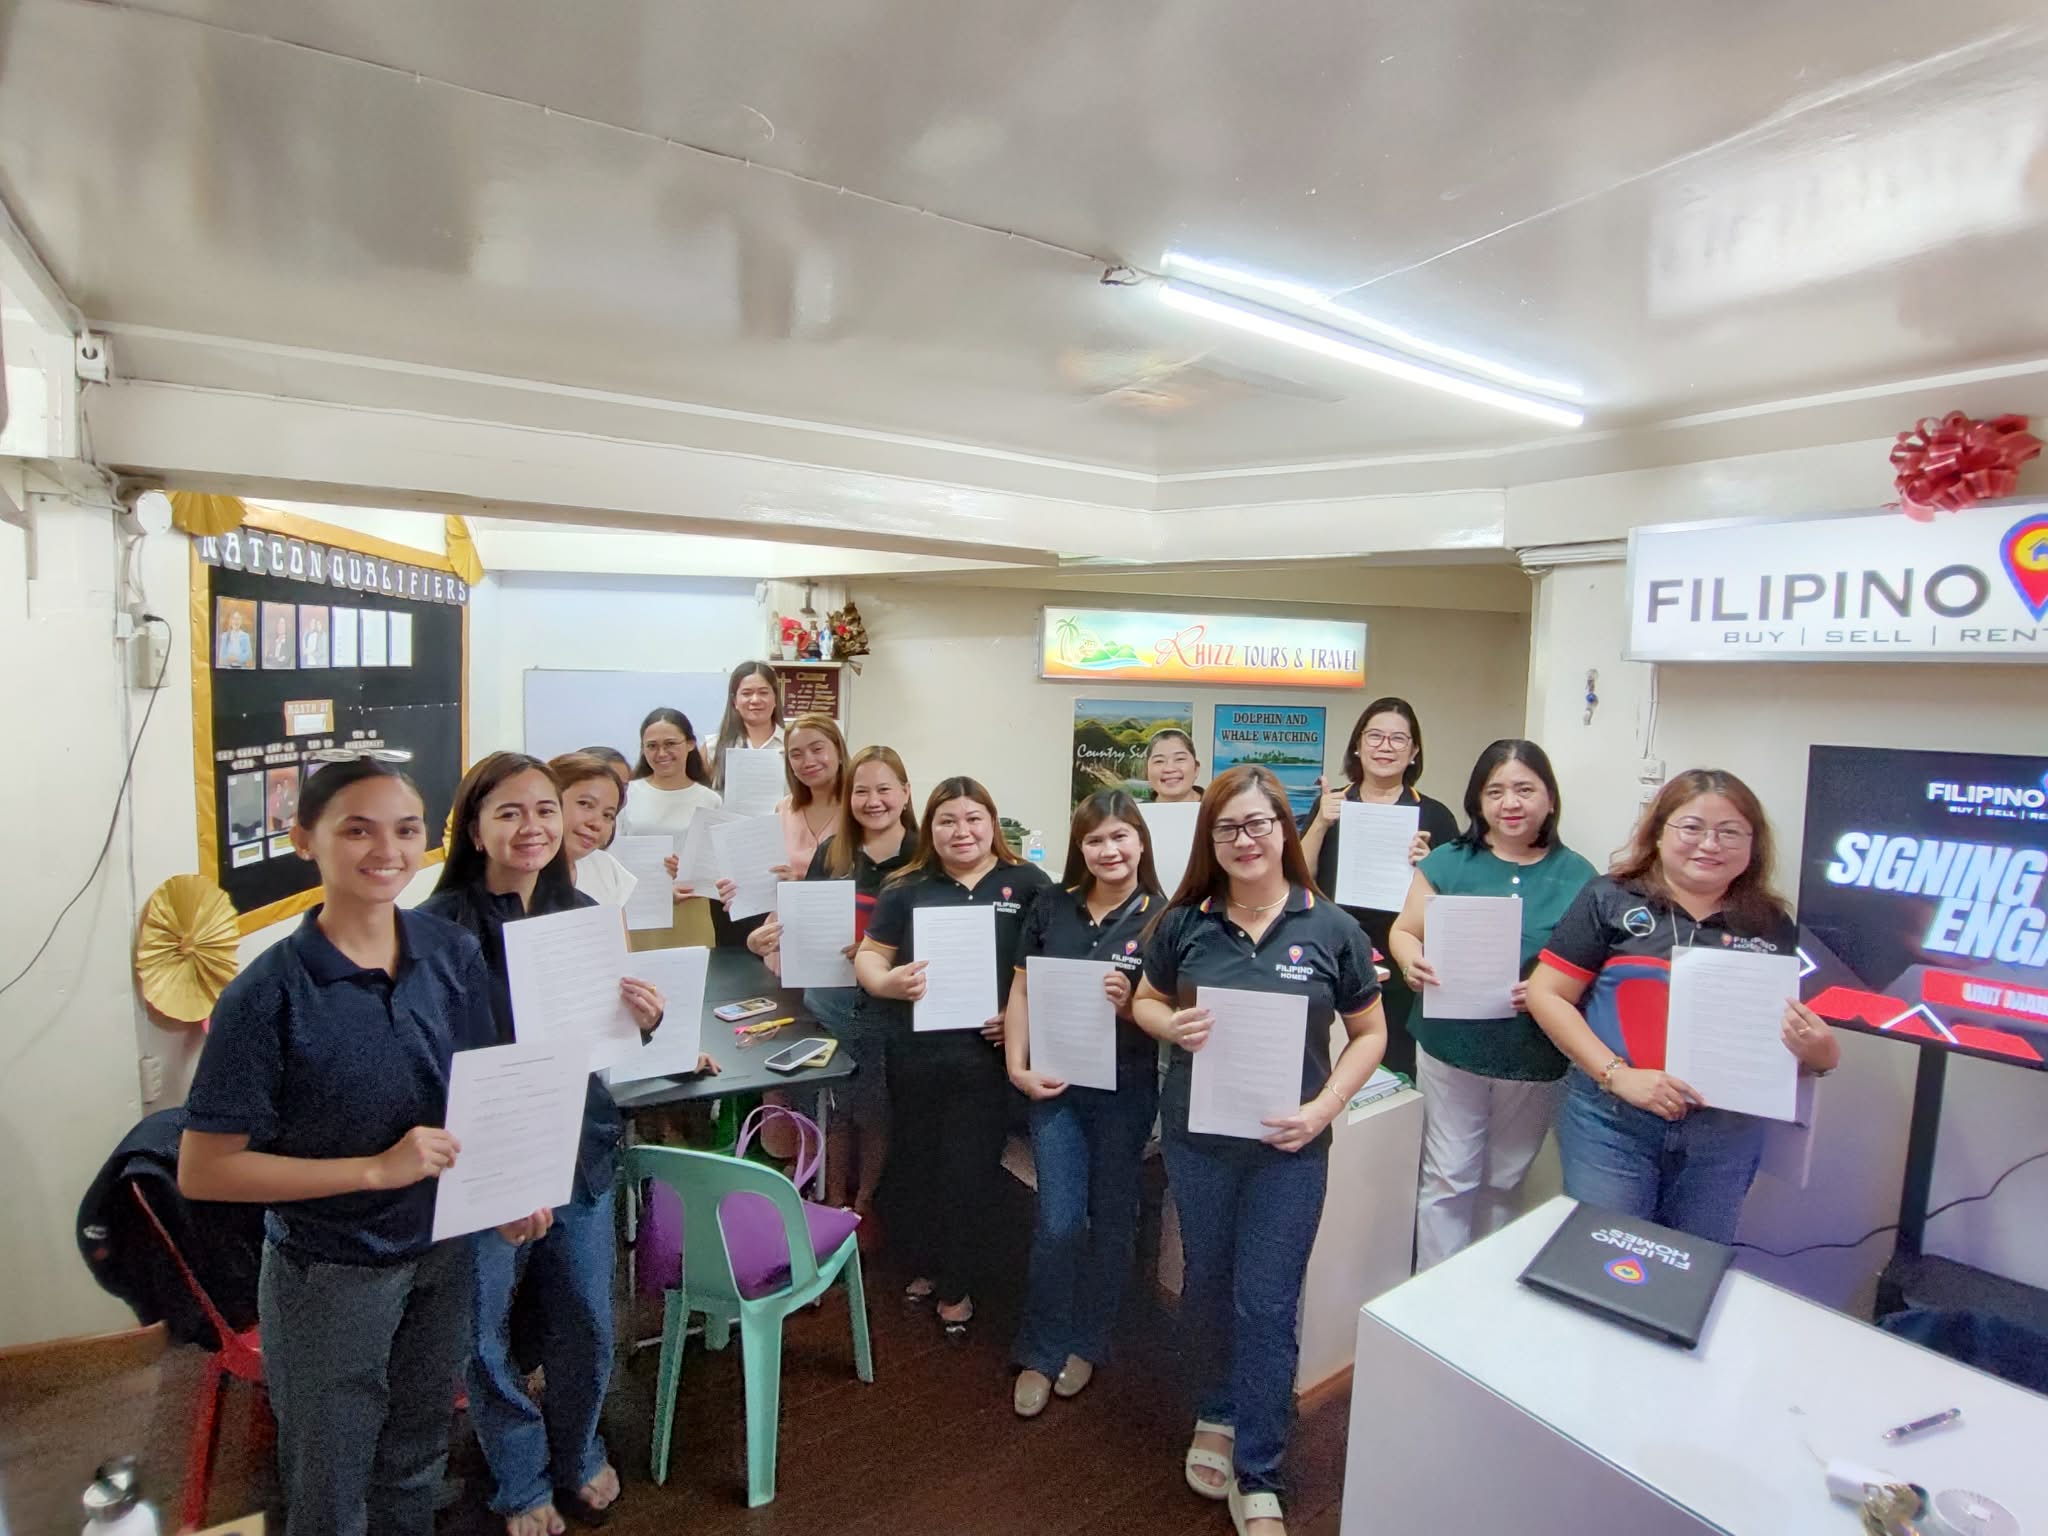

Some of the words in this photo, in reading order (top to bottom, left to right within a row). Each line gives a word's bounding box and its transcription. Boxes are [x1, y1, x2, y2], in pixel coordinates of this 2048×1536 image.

[202, 532, 322, 578] NATCON
[333, 555, 466, 601] QUALIFIERS
[1647, 564, 1991, 623] FILIPINO
[1724, 631, 1784, 643] BUY
[1825, 630, 1911, 643] SELL
[1243, 645, 1288, 668] TOURS
[1294, 648, 1304, 668] &
[1311, 648, 1359, 671] TRAVEL
[1233, 712, 1282, 724] DOLPHIN
[1286, 714, 1308, 725] AND
[1221, 729, 1259, 741] WHALE
[1263, 731, 1318, 742] WATCHING
[1077, 744, 1125, 763] Country
[1928, 782, 2045, 808] FILIPINO
[1948, 806, 1974, 814] BUY
[1826, 831, 2048, 908] SIGNING
[1111, 953, 1142, 965] FILIPINO
[1275, 963, 1314, 975] FILIPINO
[1280, 972, 1308, 981] HOMES
[1591, 1231, 1691, 1270] FILIPINO
[1609, 1228, 1690, 1261] HOMES
